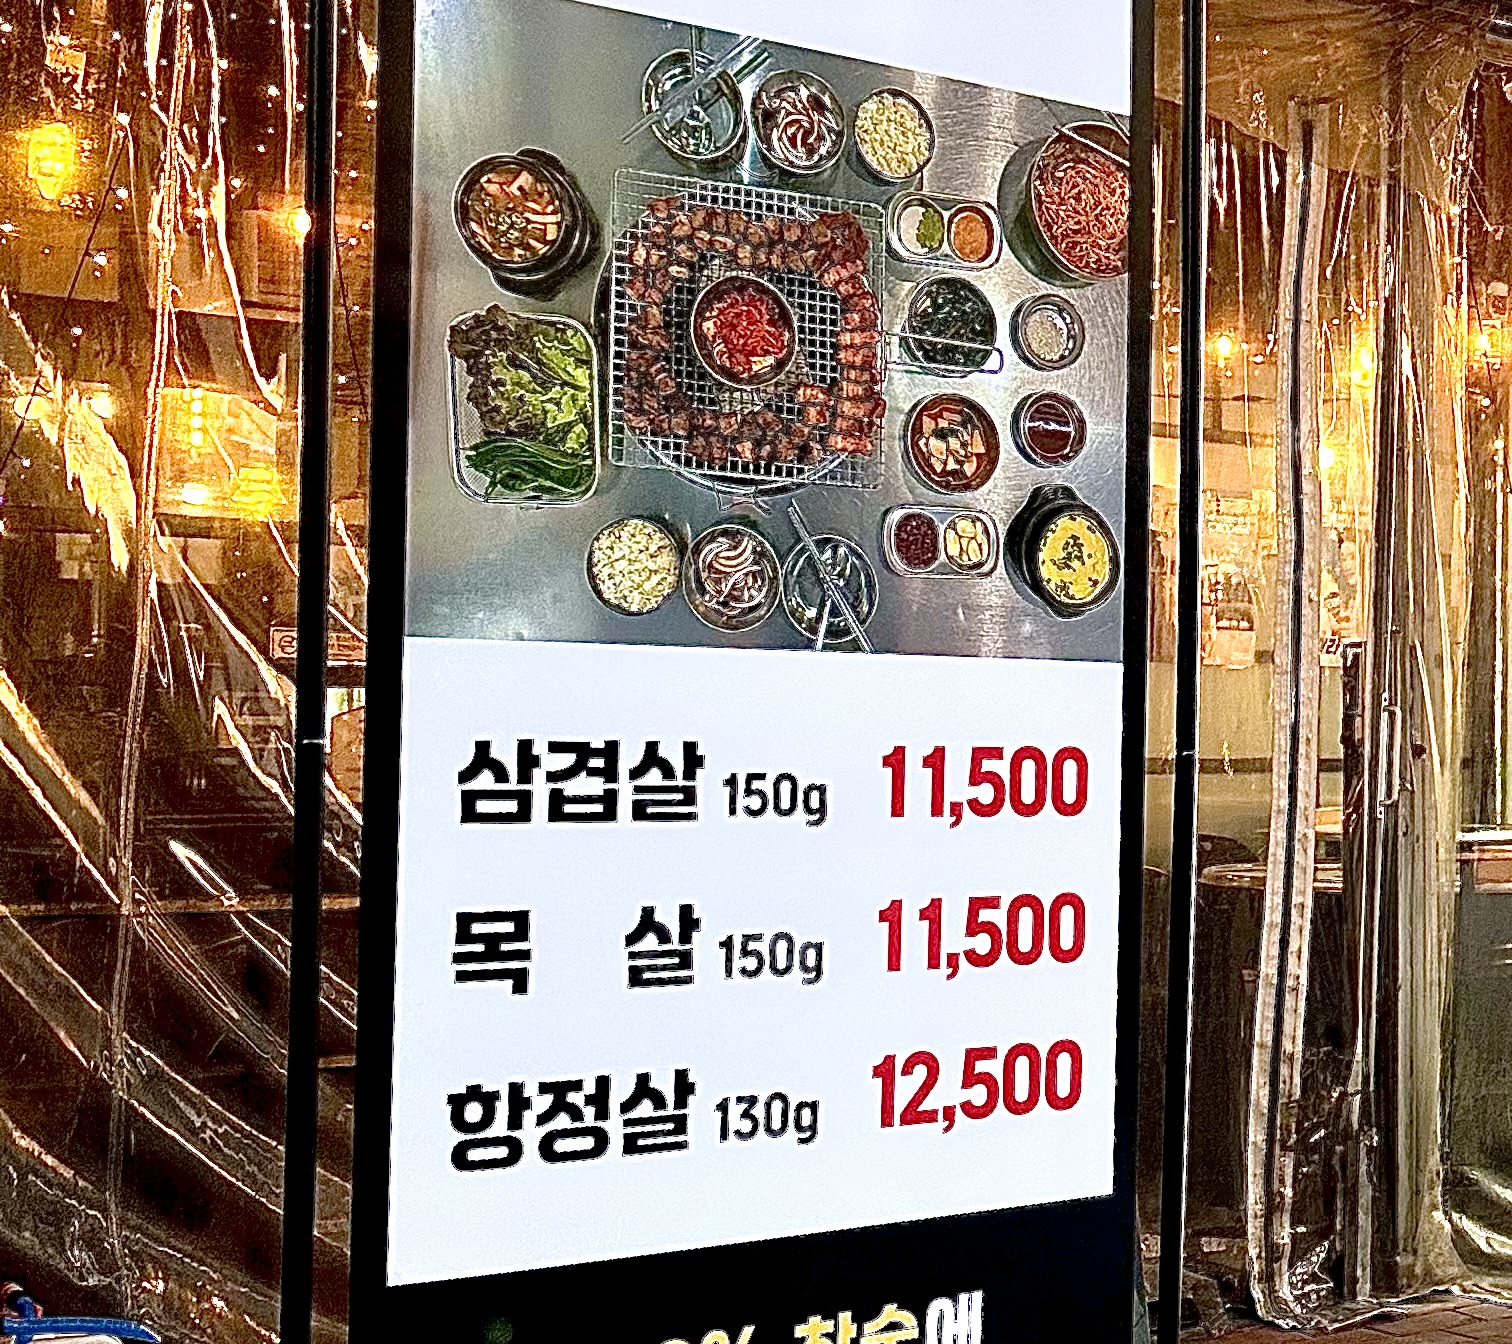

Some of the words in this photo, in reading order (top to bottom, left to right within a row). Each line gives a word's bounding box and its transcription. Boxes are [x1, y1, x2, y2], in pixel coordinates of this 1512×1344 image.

[457, 738, 705, 824] 삼겹살
[721, 771, 828, 827] 150g
[882, 745, 1088, 828] 11,500
[718, 932, 824, 986] 150g
[878, 892, 1085, 980] 11,500
[446, 1068, 696, 1173] 항정살
[714, 1091, 820, 1145] 130g
[871, 1039, 1083, 1134] 12,500
